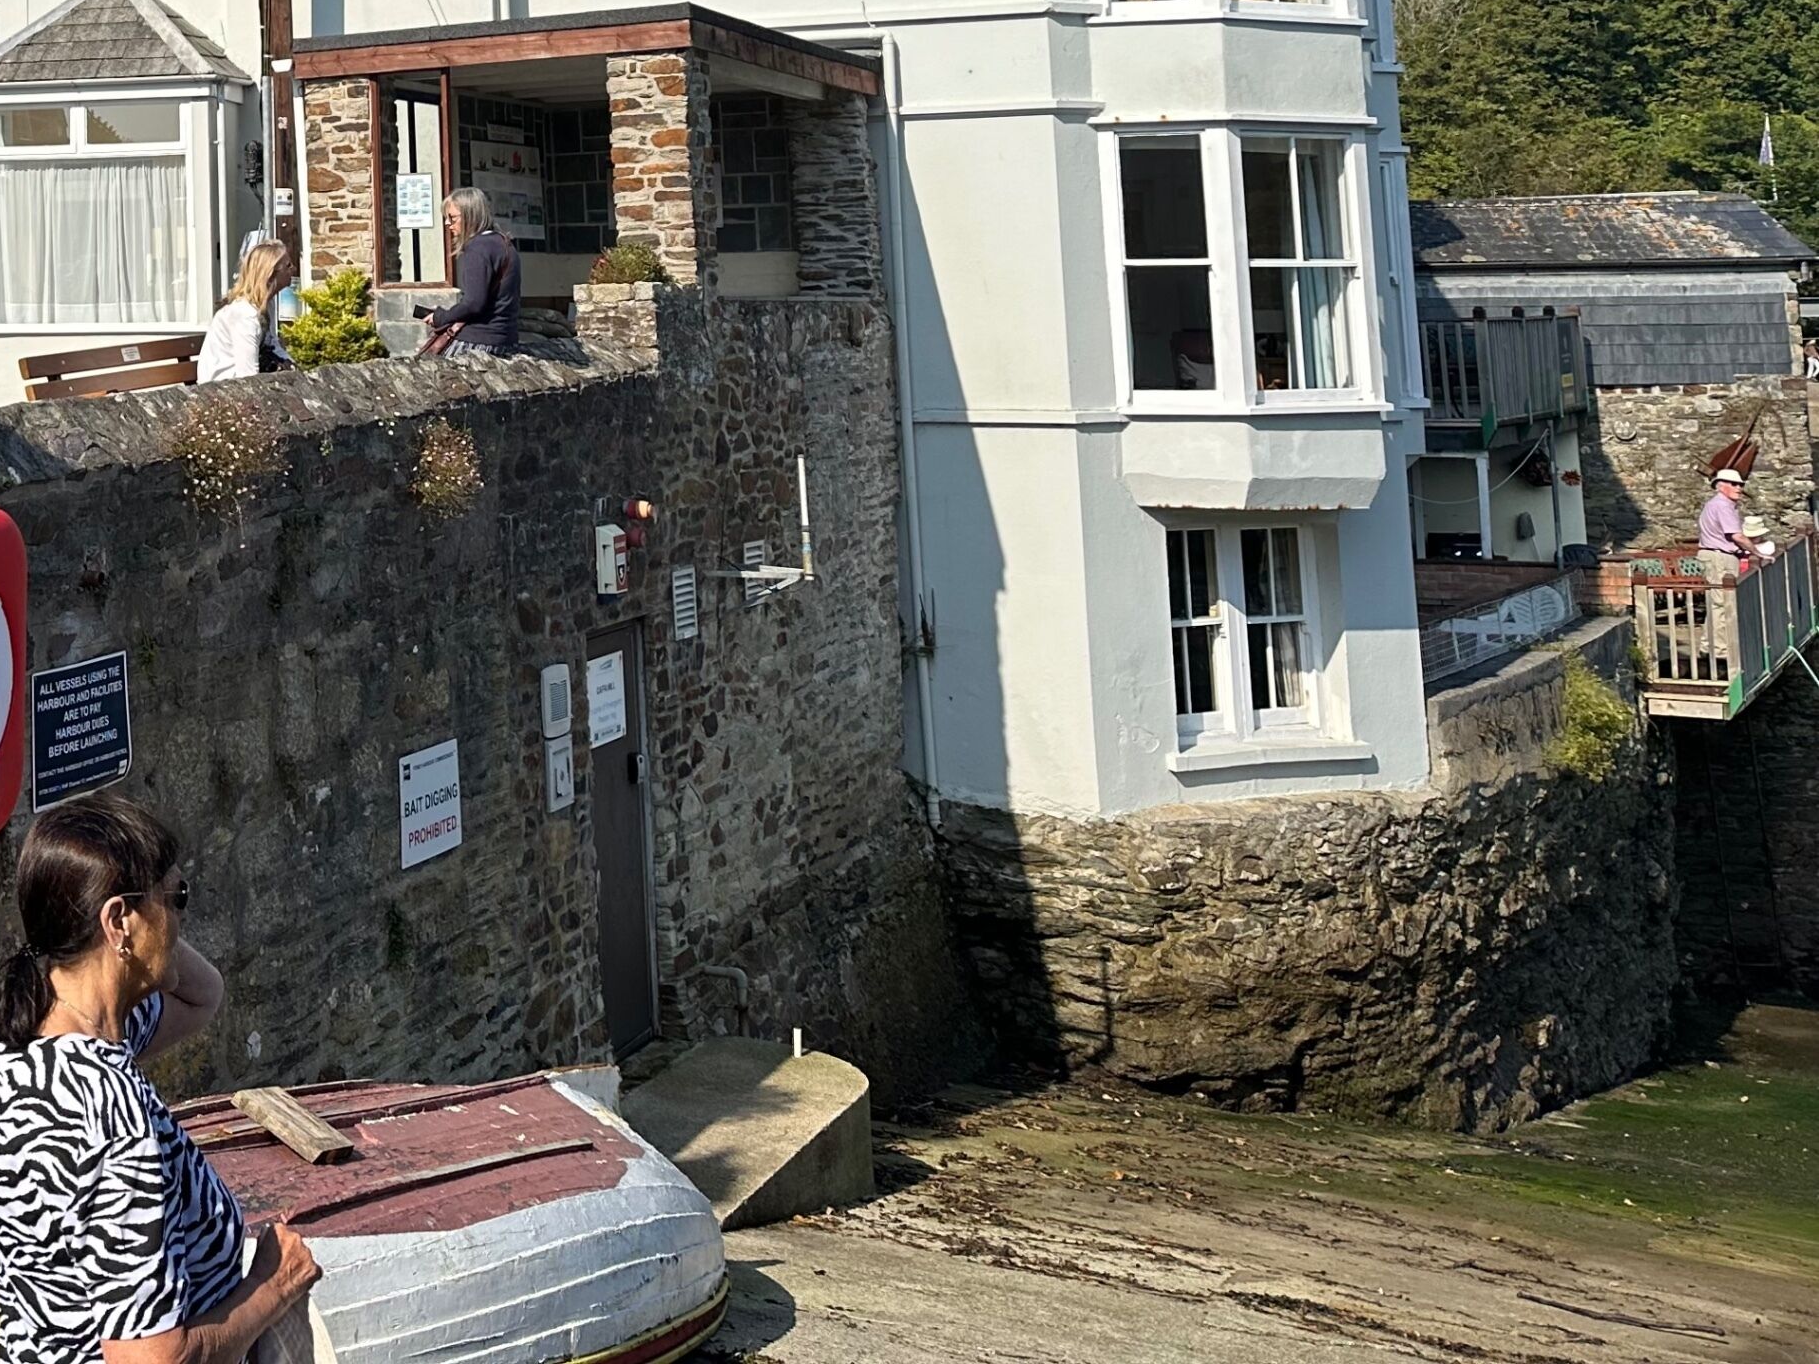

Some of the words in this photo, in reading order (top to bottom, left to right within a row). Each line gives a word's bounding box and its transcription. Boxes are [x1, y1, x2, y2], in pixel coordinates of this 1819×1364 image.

[39, 682, 55, 696] ALL
[55, 674, 87, 692] VESSELS
[87, 668, 107, 685] USING
[107, 665, 120, 677] THE
[37, 693, 76, 713] HARBOUR
[76, 689, 90, 703] AND
[90, 680, 123, 699] FACILITIES
[63, 708, 79, 722] ARE
[79, 705, 89, 717] TO
[89, 701, 102, 715] PAY
[55, 720, 91, 740] HARBOUR
[91, 714, 110, 730] DUES
[48, 739, 80, 758] BEFORE
[80, 728, 118, 749] LAUNCHING
[404, 795, 424, 818] BAIT
[424, 782, 458, 810] DIGGING
[408, 814, 458, 848] PROHIBITED
